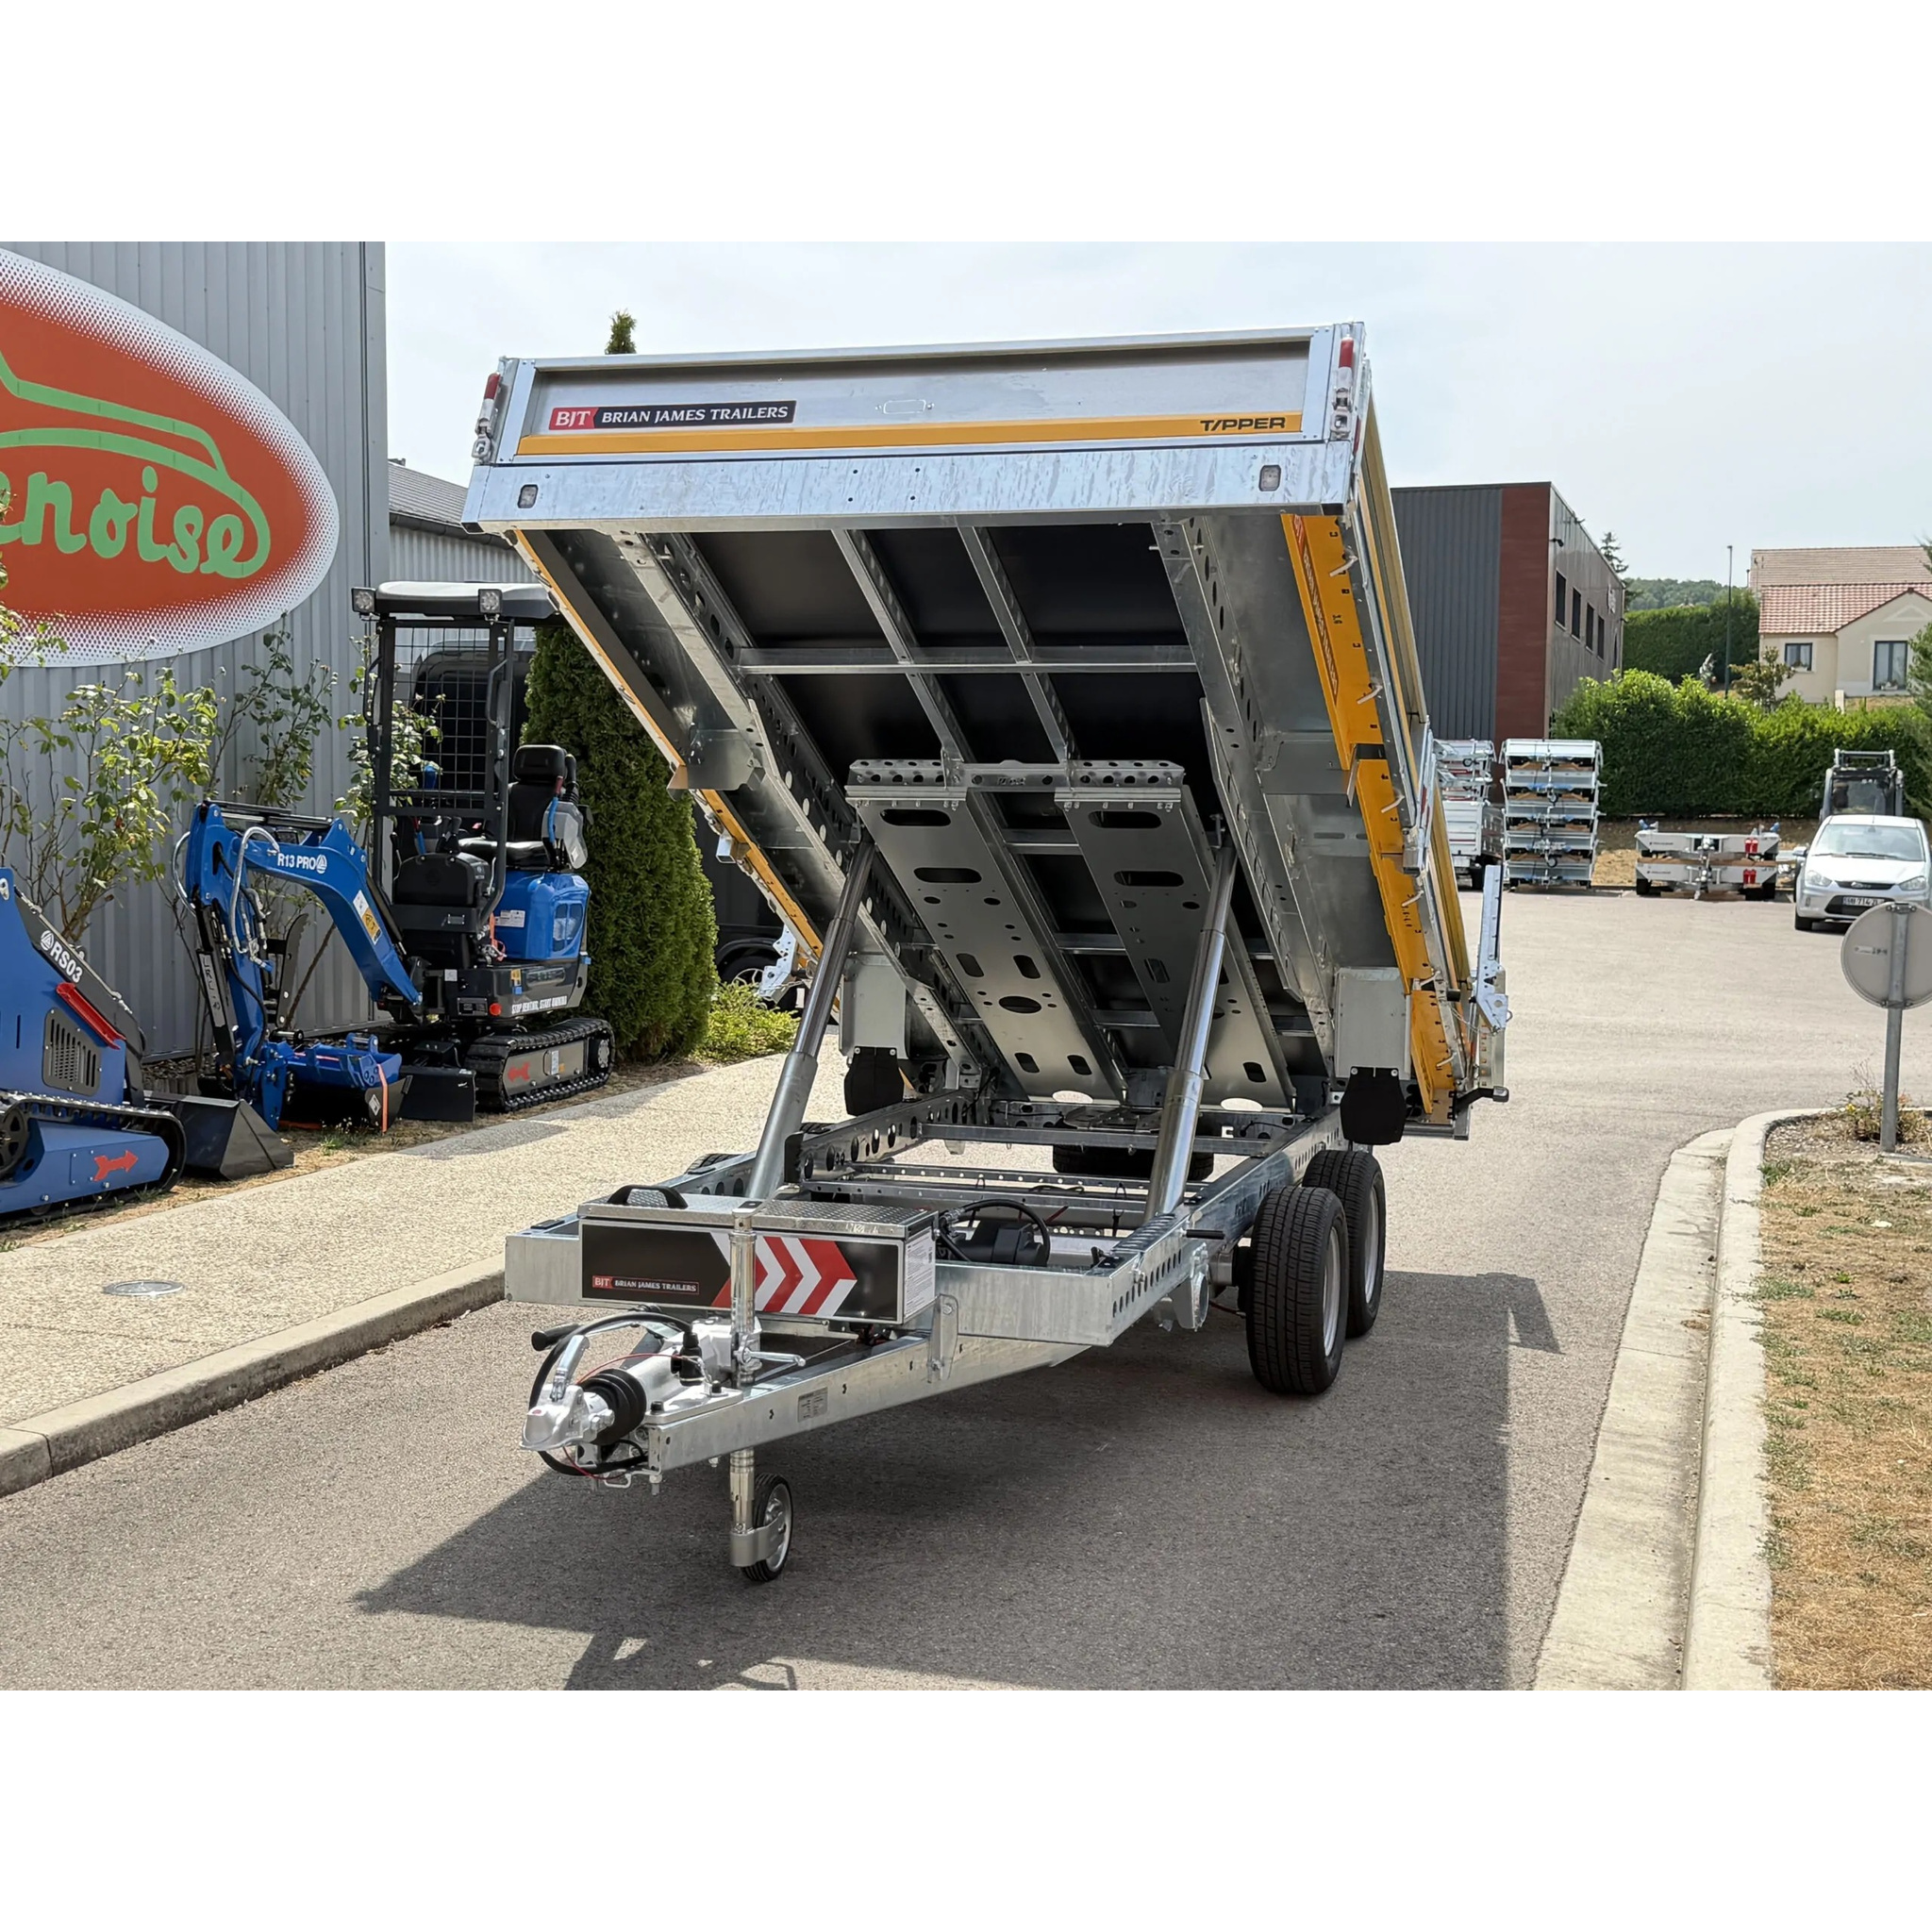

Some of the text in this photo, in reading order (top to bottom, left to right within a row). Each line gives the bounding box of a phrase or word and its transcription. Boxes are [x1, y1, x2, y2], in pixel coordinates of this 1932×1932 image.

[555, 407, 789, 427] BJT BRIAN JAMES TRAILERS
[277, 853, 316, 870] R13 PRO
[50, 941, 83, 983] RS03
[594, 1277, 697, 1291] BJT BRIAN JAMES TRAILERS
